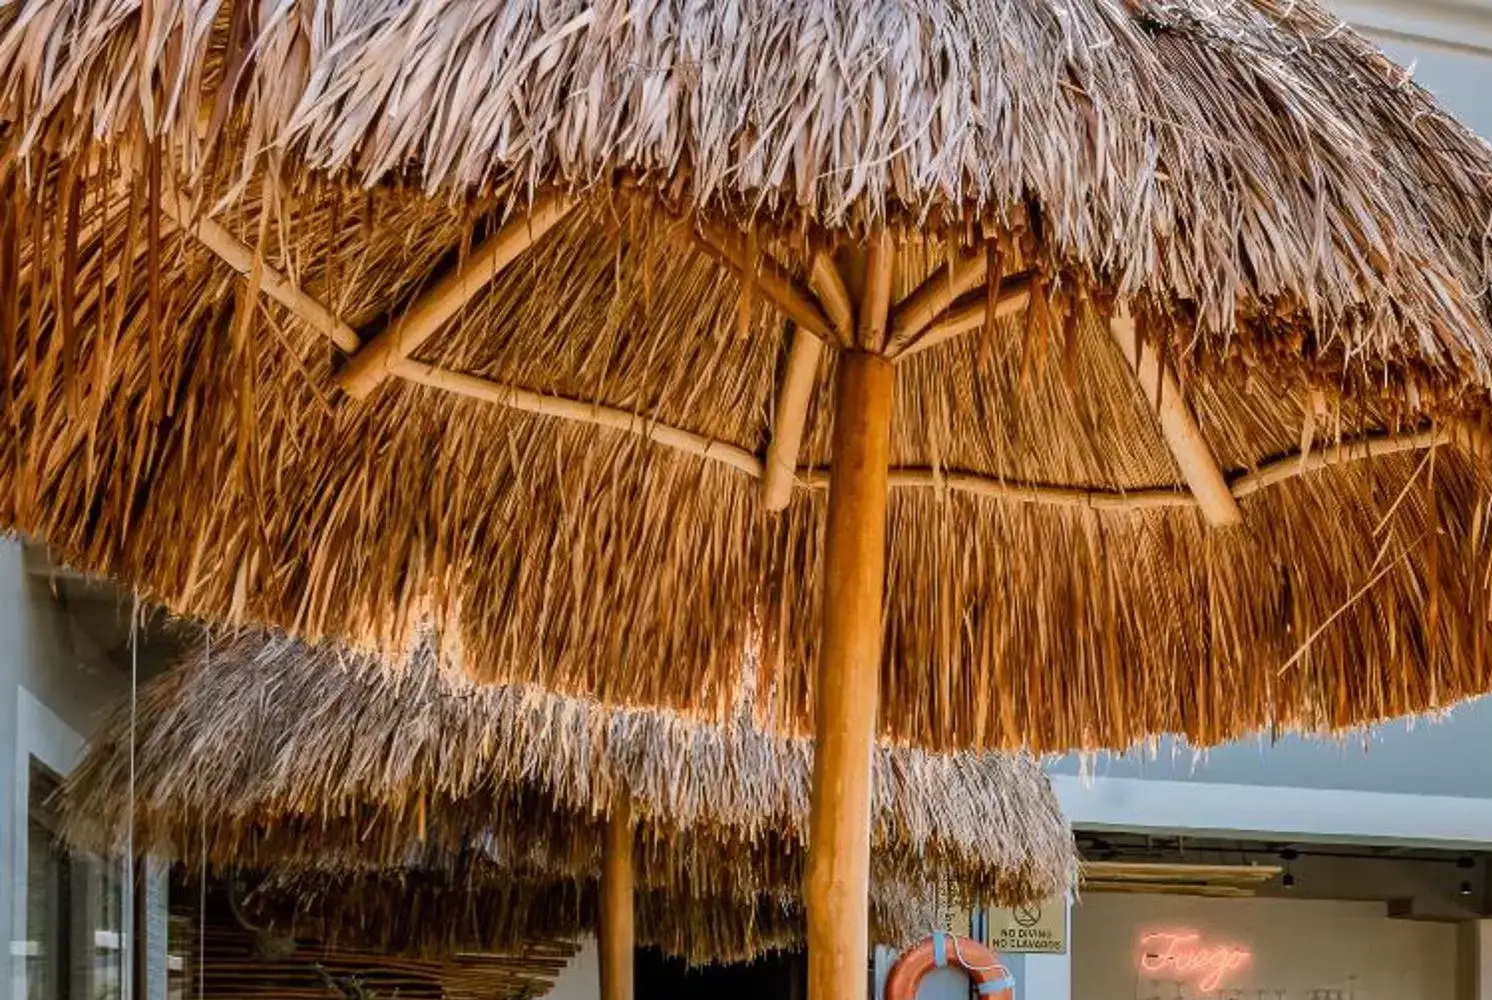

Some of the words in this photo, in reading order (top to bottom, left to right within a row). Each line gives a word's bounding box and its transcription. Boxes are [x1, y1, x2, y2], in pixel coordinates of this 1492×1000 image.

[1001, 928, 1015, 938] NO
[992, 939, 1007, 948] NO
[1142, 932, 1250, 992] Fuego
